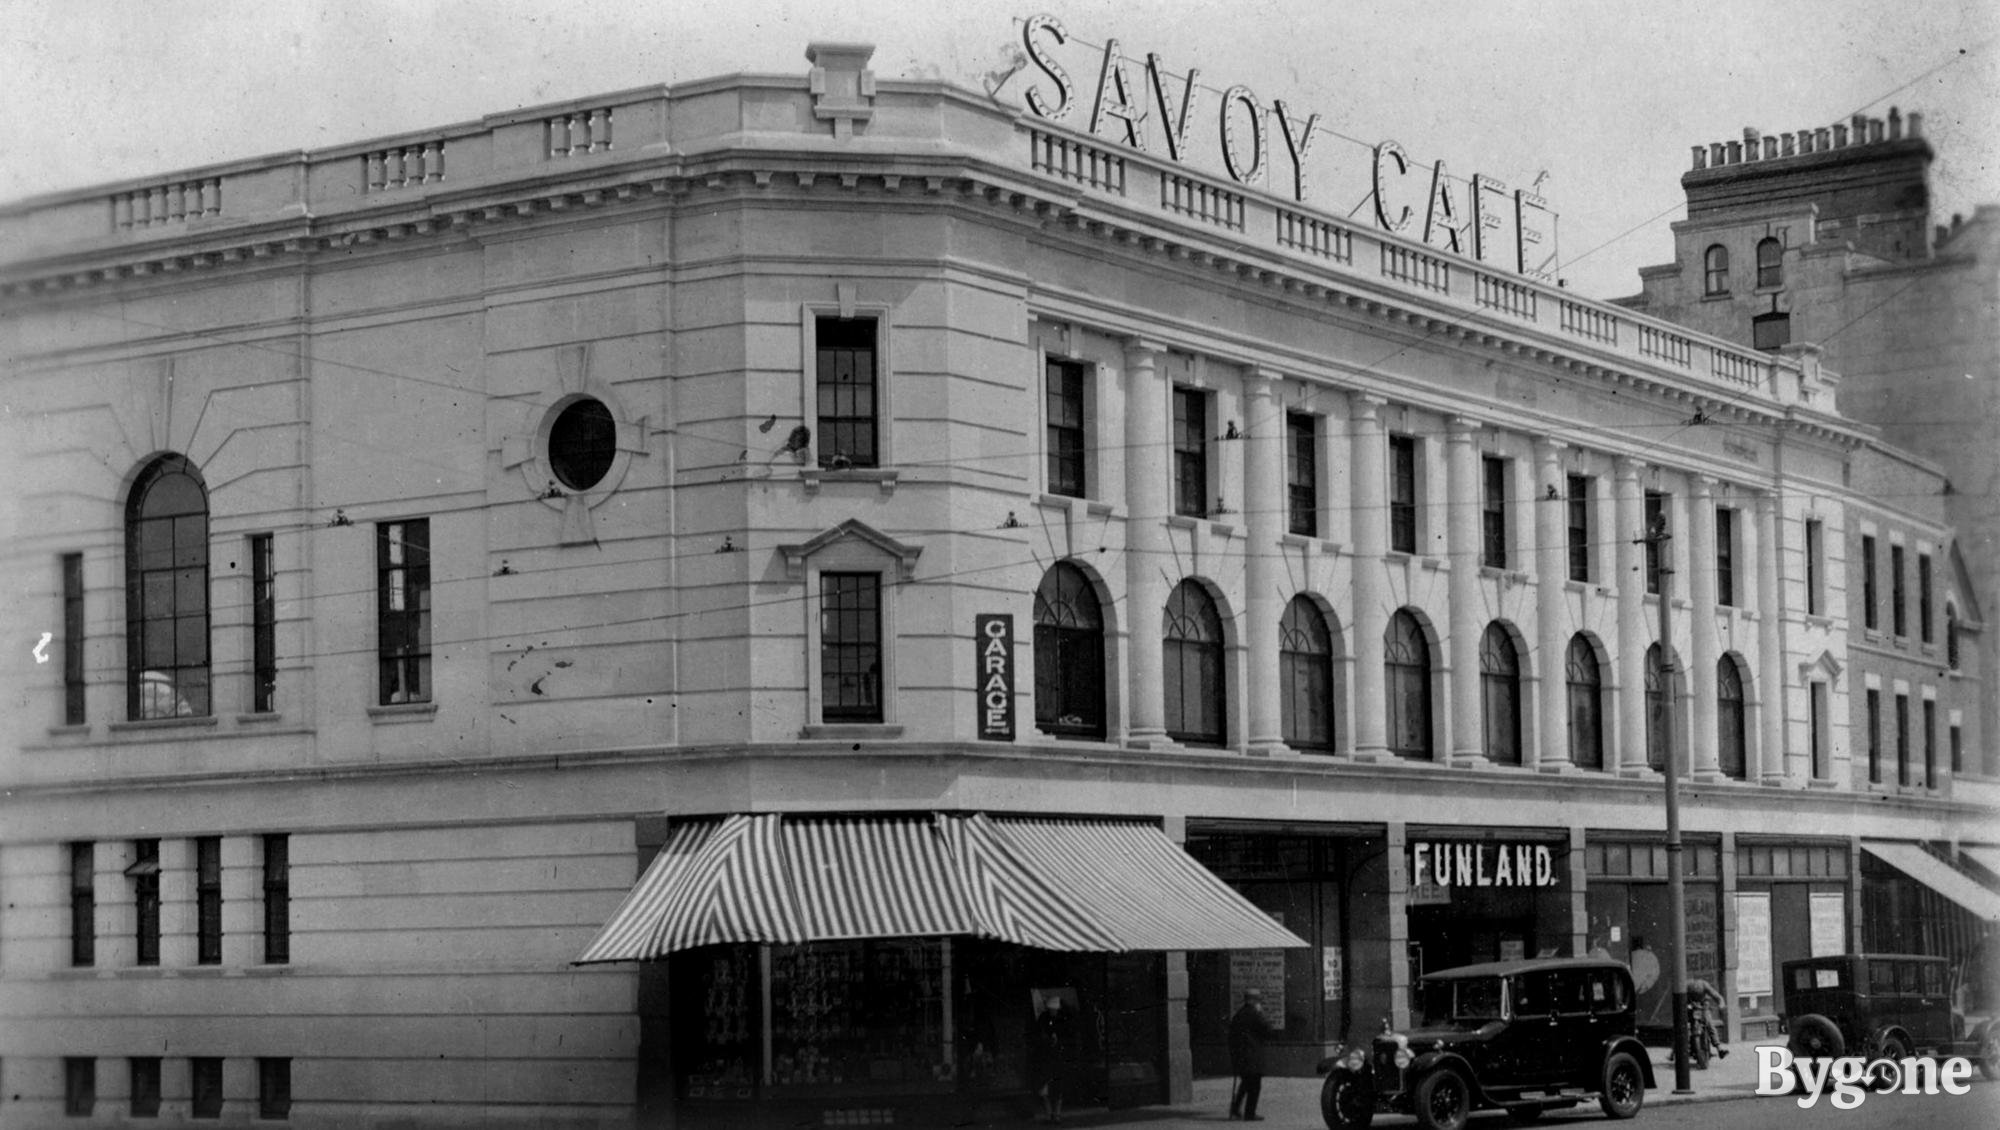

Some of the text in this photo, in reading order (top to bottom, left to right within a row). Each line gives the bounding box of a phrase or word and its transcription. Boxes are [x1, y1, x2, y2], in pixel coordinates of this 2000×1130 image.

[1023, 14, 1556, 286] SAVOY CAFÉ
[984, 620, 1008, 727] GARAGE
[1414, 842, 1557, 887] FUNLAND.
